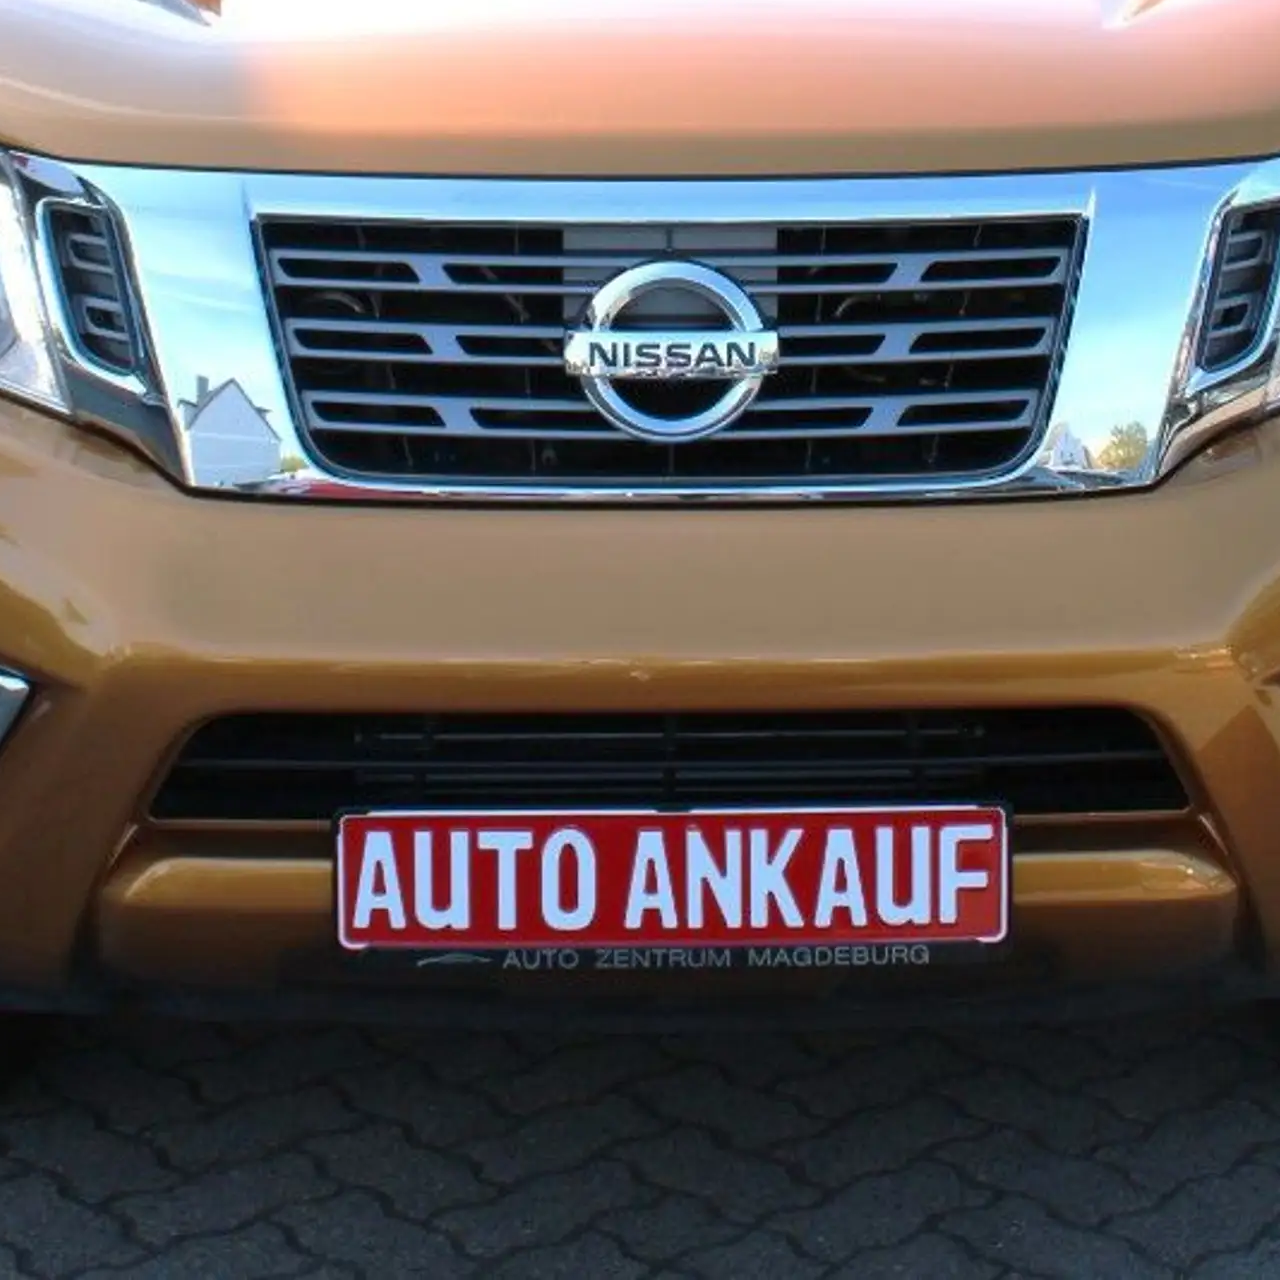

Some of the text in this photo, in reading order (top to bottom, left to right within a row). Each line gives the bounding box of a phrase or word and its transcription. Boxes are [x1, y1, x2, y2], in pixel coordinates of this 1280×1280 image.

[589, 341, 756, 368] NISSAN
[352, 824, 994, 931] AUTO ANKAUF
[503, 944, 931, 970] AUTO ZENTRUM MAGDEBURG
